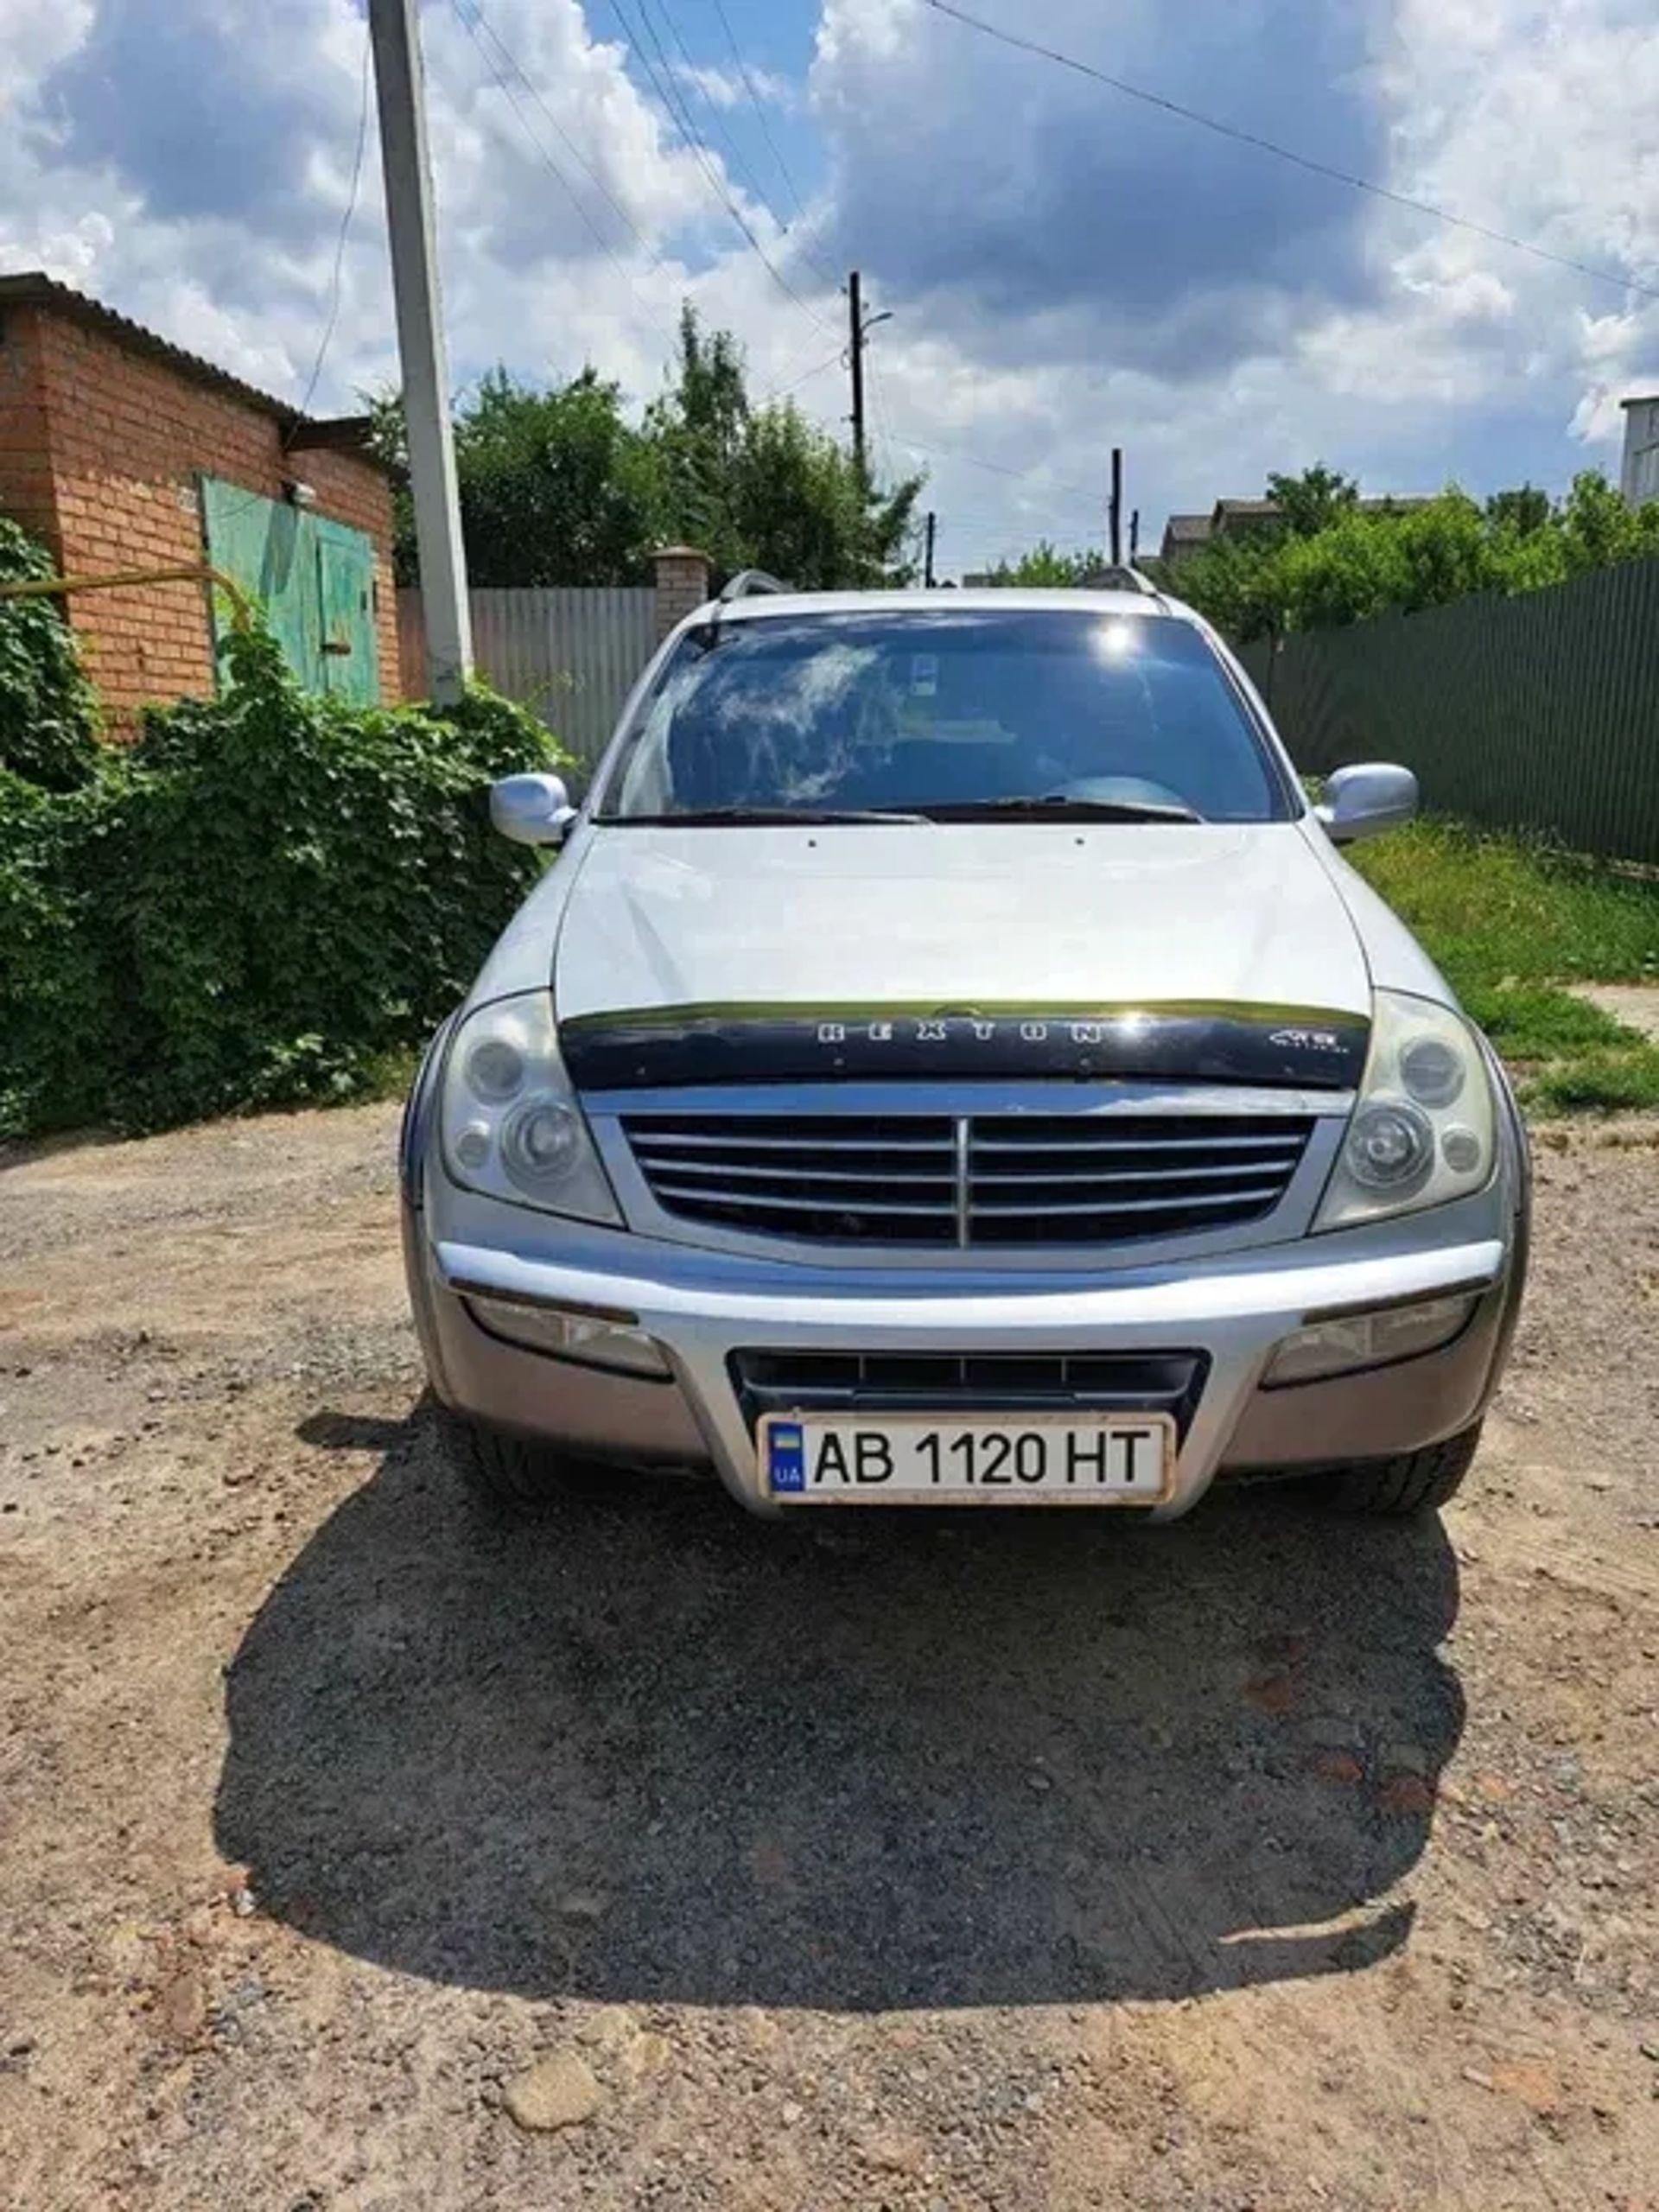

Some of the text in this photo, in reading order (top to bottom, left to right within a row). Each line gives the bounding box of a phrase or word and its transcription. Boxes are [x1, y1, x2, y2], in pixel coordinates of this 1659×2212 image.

[817, 1021, 1102, 1043] REXTON
[814, 1431, 1150, 1484] AB 1120 HT
[774, 1467, 801, 1483] UA
